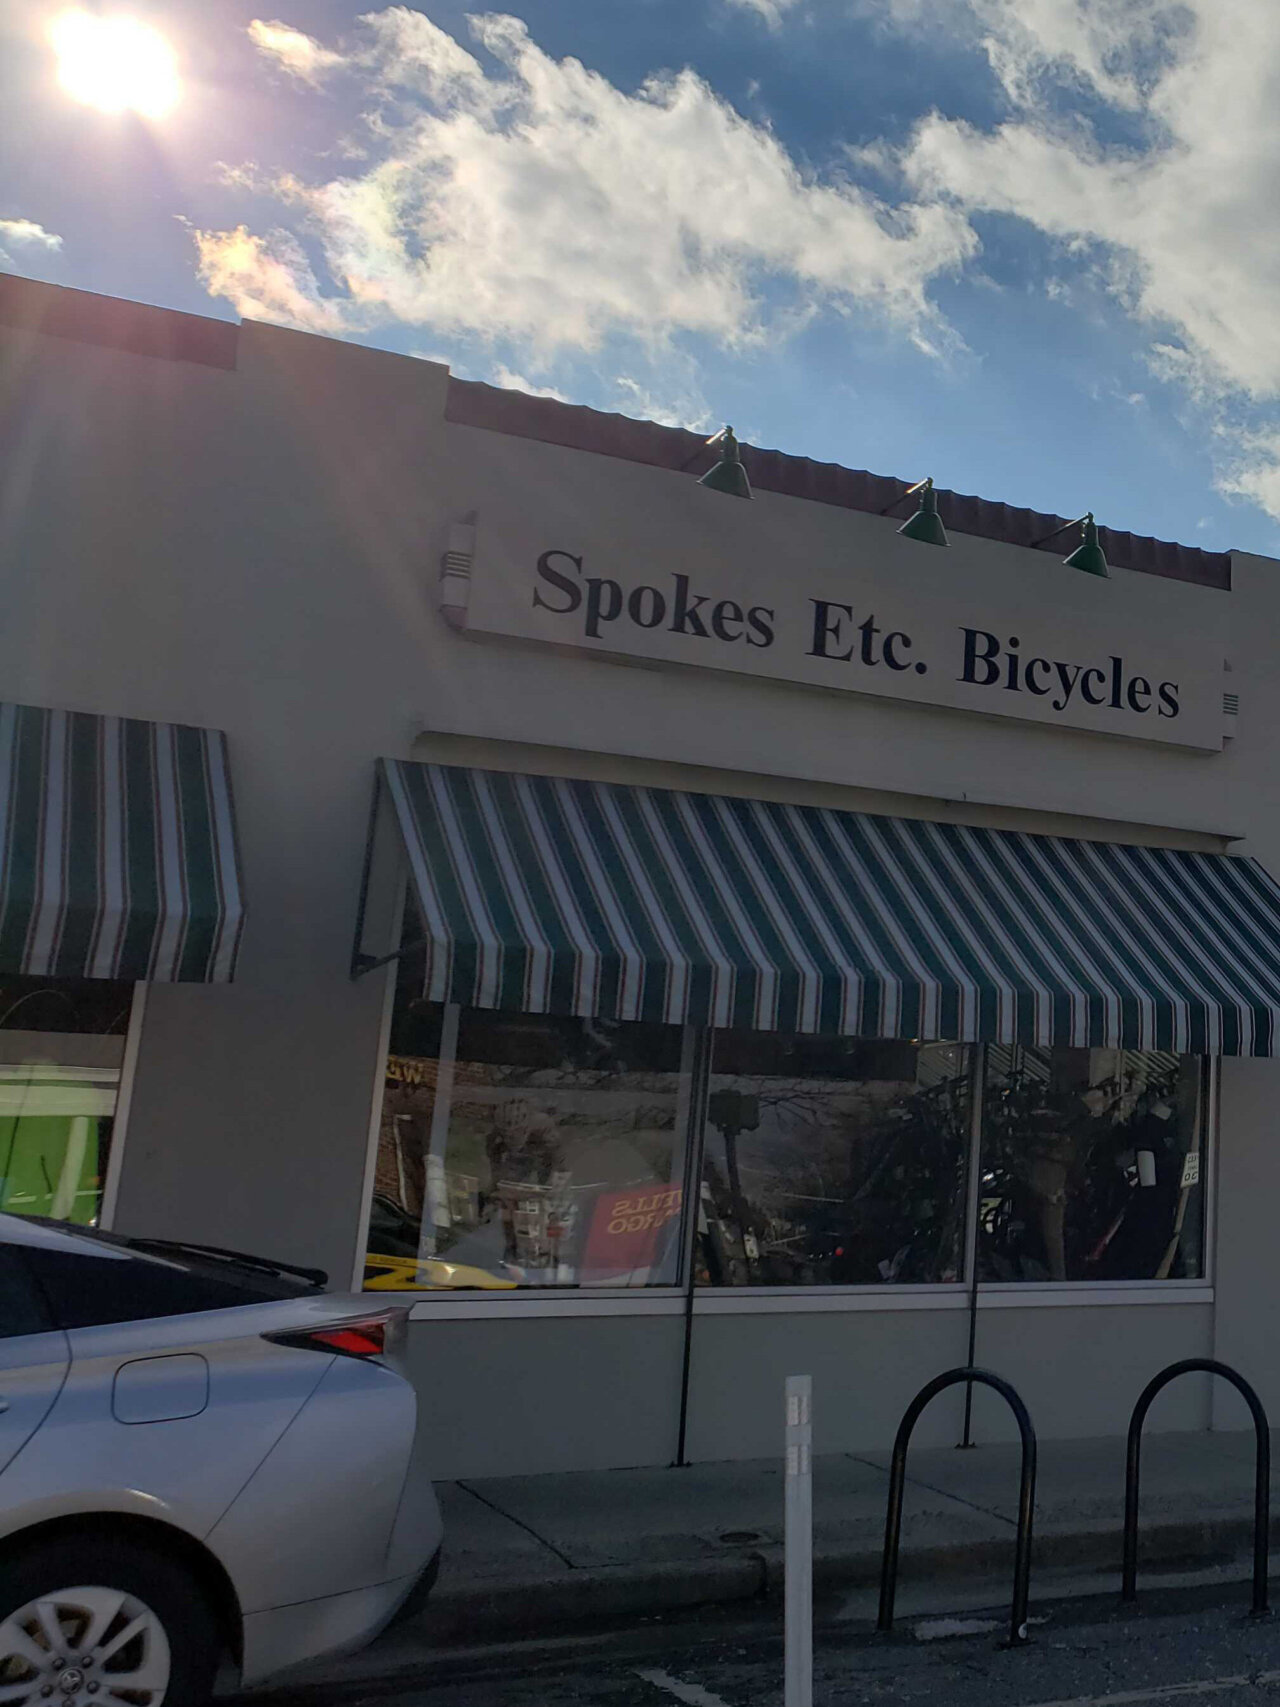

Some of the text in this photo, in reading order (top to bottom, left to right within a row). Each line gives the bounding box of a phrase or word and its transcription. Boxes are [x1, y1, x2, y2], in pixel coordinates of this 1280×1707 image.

[531, 548, 1181, 720] Spokes Etc. Bicycles
